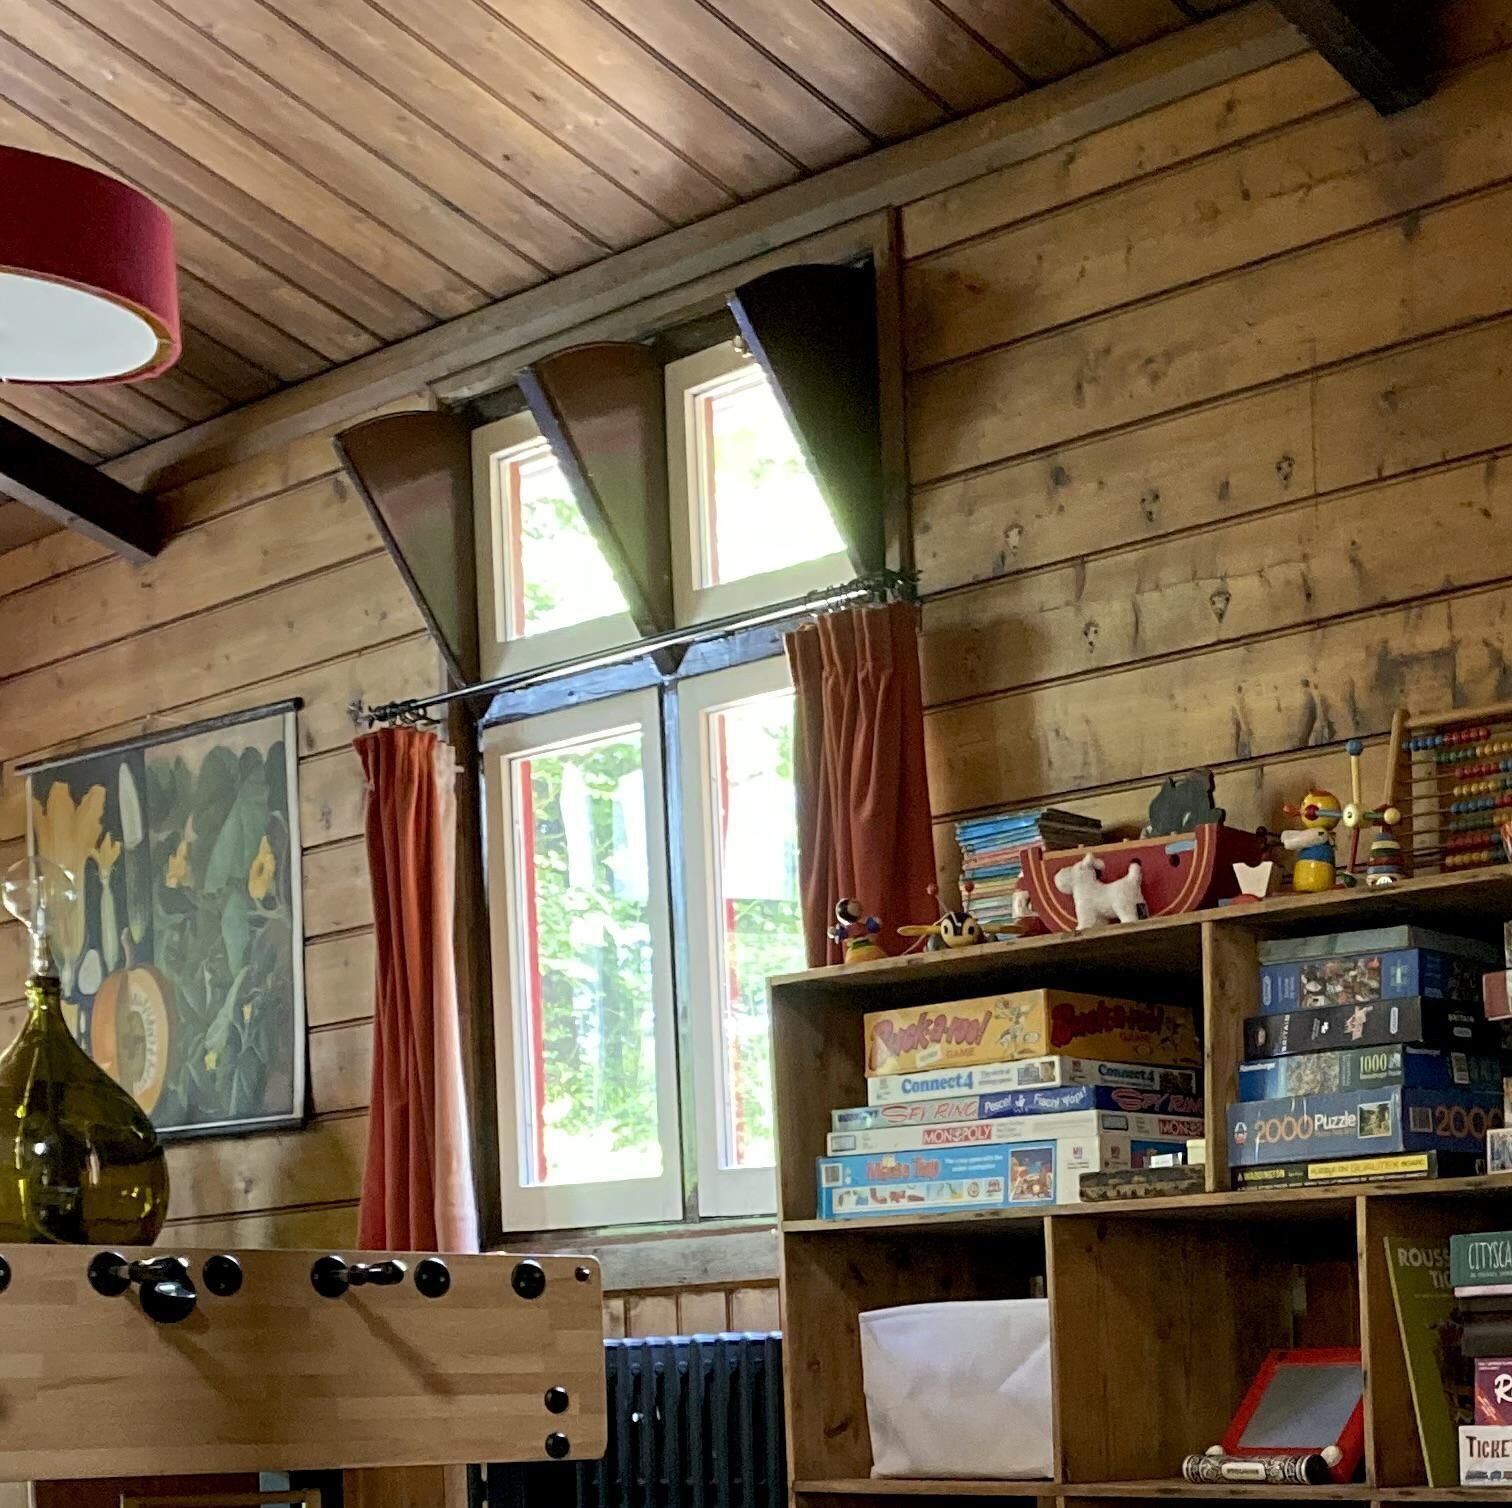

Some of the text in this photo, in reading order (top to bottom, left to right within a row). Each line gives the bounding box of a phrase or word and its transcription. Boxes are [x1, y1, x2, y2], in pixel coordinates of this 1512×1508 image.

[1098, 1063, 1145, 1079] Connect
[1359, 1052, 1388, 1074] 1000
[901, 1075, 962, 1094] Connect
[961, 1071, 973, 1090] 4
[933, 1101, 977, 1119] RING
[923, 1124, 991, 1145] MONOPOLY
[1254, 1110, 1357, 1144] 2000 Puzzle
